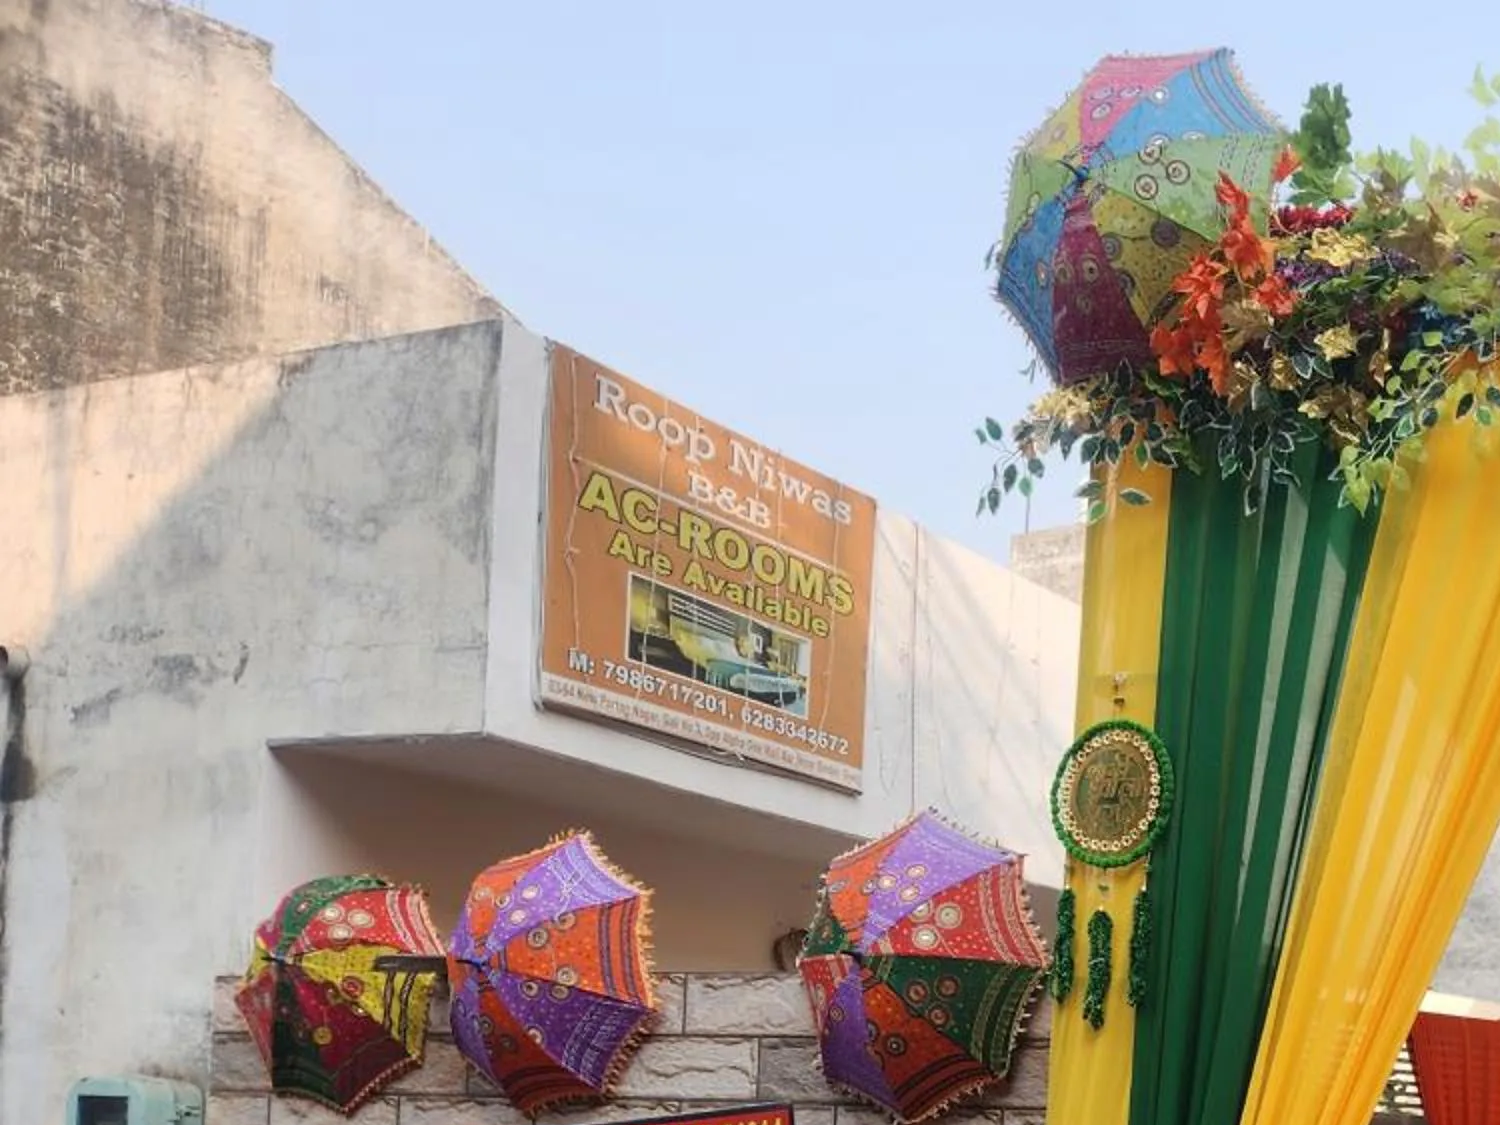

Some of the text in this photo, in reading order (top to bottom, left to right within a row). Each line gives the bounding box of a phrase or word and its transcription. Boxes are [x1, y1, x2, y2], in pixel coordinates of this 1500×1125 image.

[594, 374, 851, 524] Roop Niwas
[688, 468, 771, 528] B&B
[578, 471, 854, 616] AC-ROOMS
[608, 529, 831, 638] Are Available
